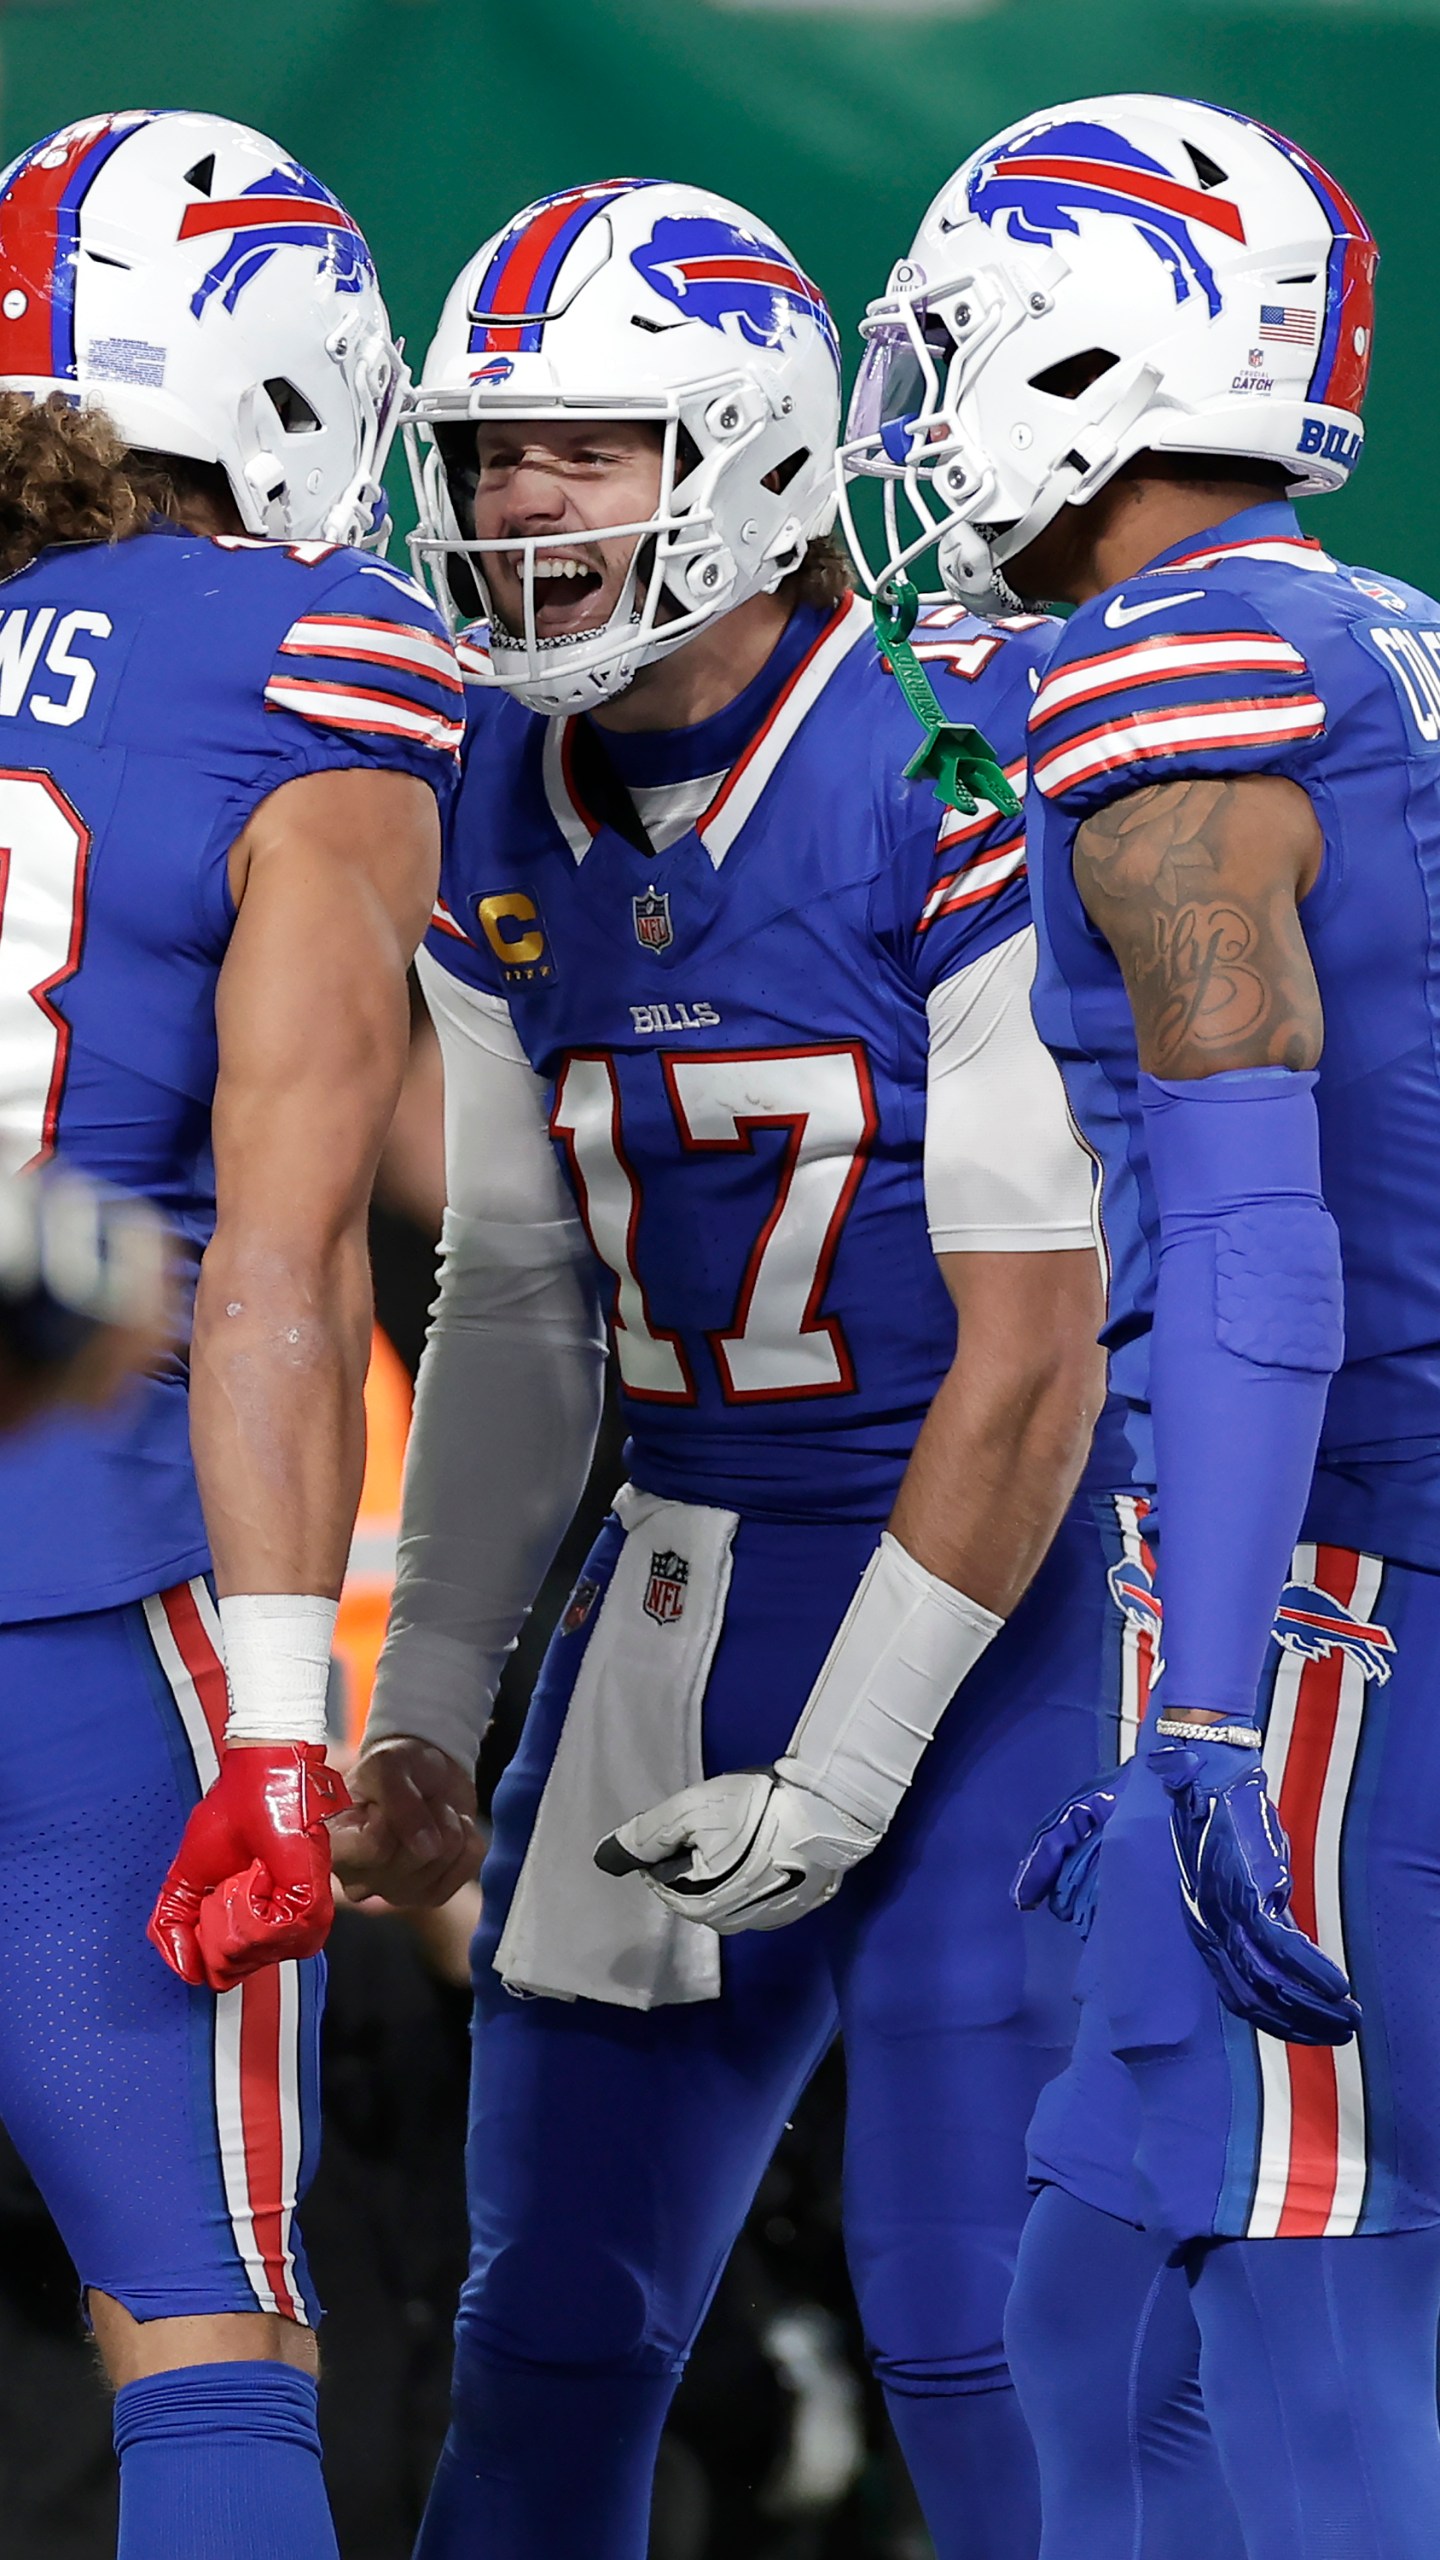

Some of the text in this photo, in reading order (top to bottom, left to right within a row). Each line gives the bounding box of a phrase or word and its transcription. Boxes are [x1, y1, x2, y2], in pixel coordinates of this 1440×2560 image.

[1232, 377, 1274, 391] CATCH
[1240, 370, 1269, 378] CRUCIAL
[0, 608, 113, 727] NS
[478, 892, 544, 964] C
[639, 918, 669, 943] NFL
[629, 1002, 721, 1034] BILLS
[549, 1038, 880, 1408] 17
[647, 1578, 684, 1618] NFL
